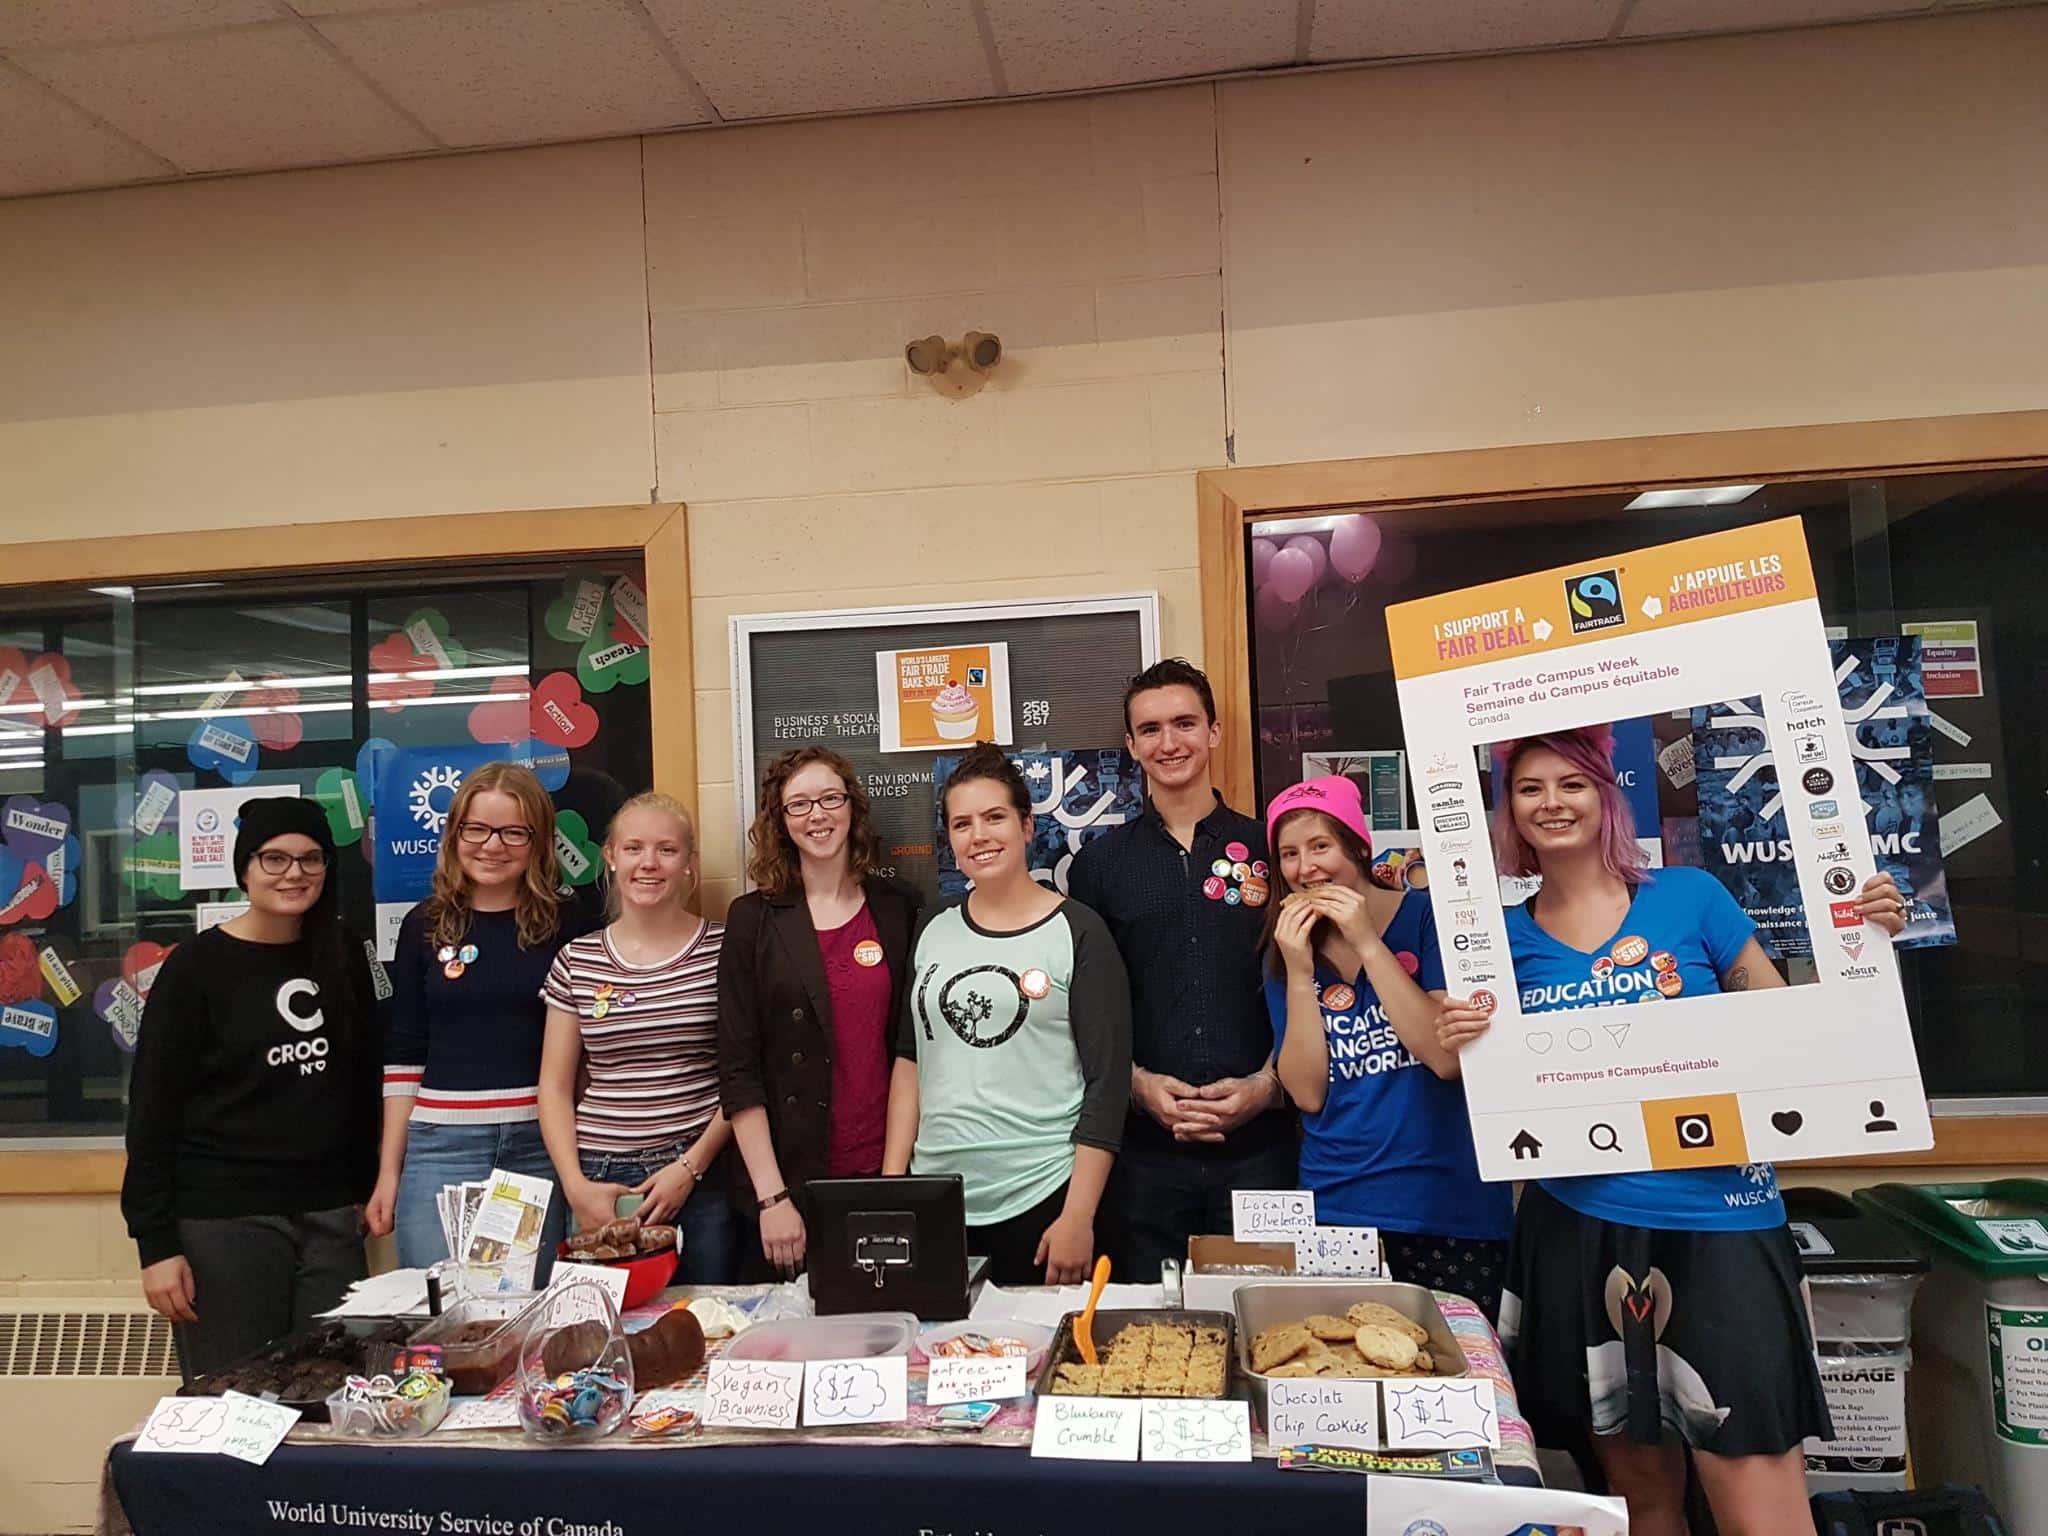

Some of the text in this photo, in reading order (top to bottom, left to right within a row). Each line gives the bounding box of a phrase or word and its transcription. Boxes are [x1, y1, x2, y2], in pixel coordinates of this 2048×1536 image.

[1669, 554, 1782, 594] J'APPUIE LES
[1668, 575, 1787, 613] AGRICULTEURS
[572, 596, 589, 623] GET
[580, 589, 602, 635] AHEAD
[1433, 606, 1526, 641] I SUPPORT A
[1573, 614, 1623, 632] FAIRTRADE
[1436, 624, 1532, 661] FAIR DEAL
[1925, 648, 1957, 659] Equality
[594, 645, 638, 667] Reach
[901, 661, 951, 677] FAIR TRADE
[1463, 655, 1640, 699] Fair Trade Campus Week
[1925, 670, 1961, 681] Inclusion
[901, 674, 946, 689] BAKE SALE
[1466, 665, 1680, 714] Semaine du Campus équitable
[545, 702, 573, 734] Action
[1022, 700, 1050, 714] 258
[774, 714, 830, 728] BUSINESS
[833, 714, 843, 726] &
[774, 722, 882, 739] LECTURE THEATR
[1023, 713, 1050, 727] 257
[1467, 711, 1511, 728] Canada
[1785, 716, 1826, 732] hatch
[868, 771, 936, 785] ENVIRONME
[867, 784, 909, 798] RVICES
[10, 812, 64, 839] Wonder
[391, 838, 437, 857] WUSC
[889, 845, 935, 857] GROUND
[1720, 838, 1794, 864] WUS
[1869, 831, 1922, 856] MC
[1513, 880, 1537, 890] THE
[1754, 919, 1803, 931] naissance
[1521, 969, 1655, 1009] EDUCATION
[276, 977, 325, 1033] C
[4, 1010, 52, 1036] Be Brave
[266, 1036, 329, 1066] CROO
[1536, 1058, 1719, 1084] #FTCampus #CampusÉquitable
[1242, 1196, 1285, 1210] Local
[1723, 1189, 1767, 1209] WUSC
[1317, 1233, 1343, 1259] $2
[1820, 1367, 1896, 1382] ARBAGE
[720, 1375, 779, 1399] Vegan
[827, 1374, 858, 1402] $1
[1270, 1382, 1345, 1408] Chocolate
[159, 1406, 207, 1434] $1
[718, 1399, 785, 1419] Brownies
[1054, 1402, 1125, 1424] Blueberry
[1413, 1394, 1454, 1425] $1
[1173, 1415, 1212, 1443] $1
[1272, 1412, 1369, 1437] Chip Cookies
[1056, 1429, 1117, 1447] Crumble
[1308, 1451, 1443, 1473] FAIR TRADE
[1317, 1446, 1374, 1459] PROUD
[267, 1499, 624, 1536] World University Service of Canada
